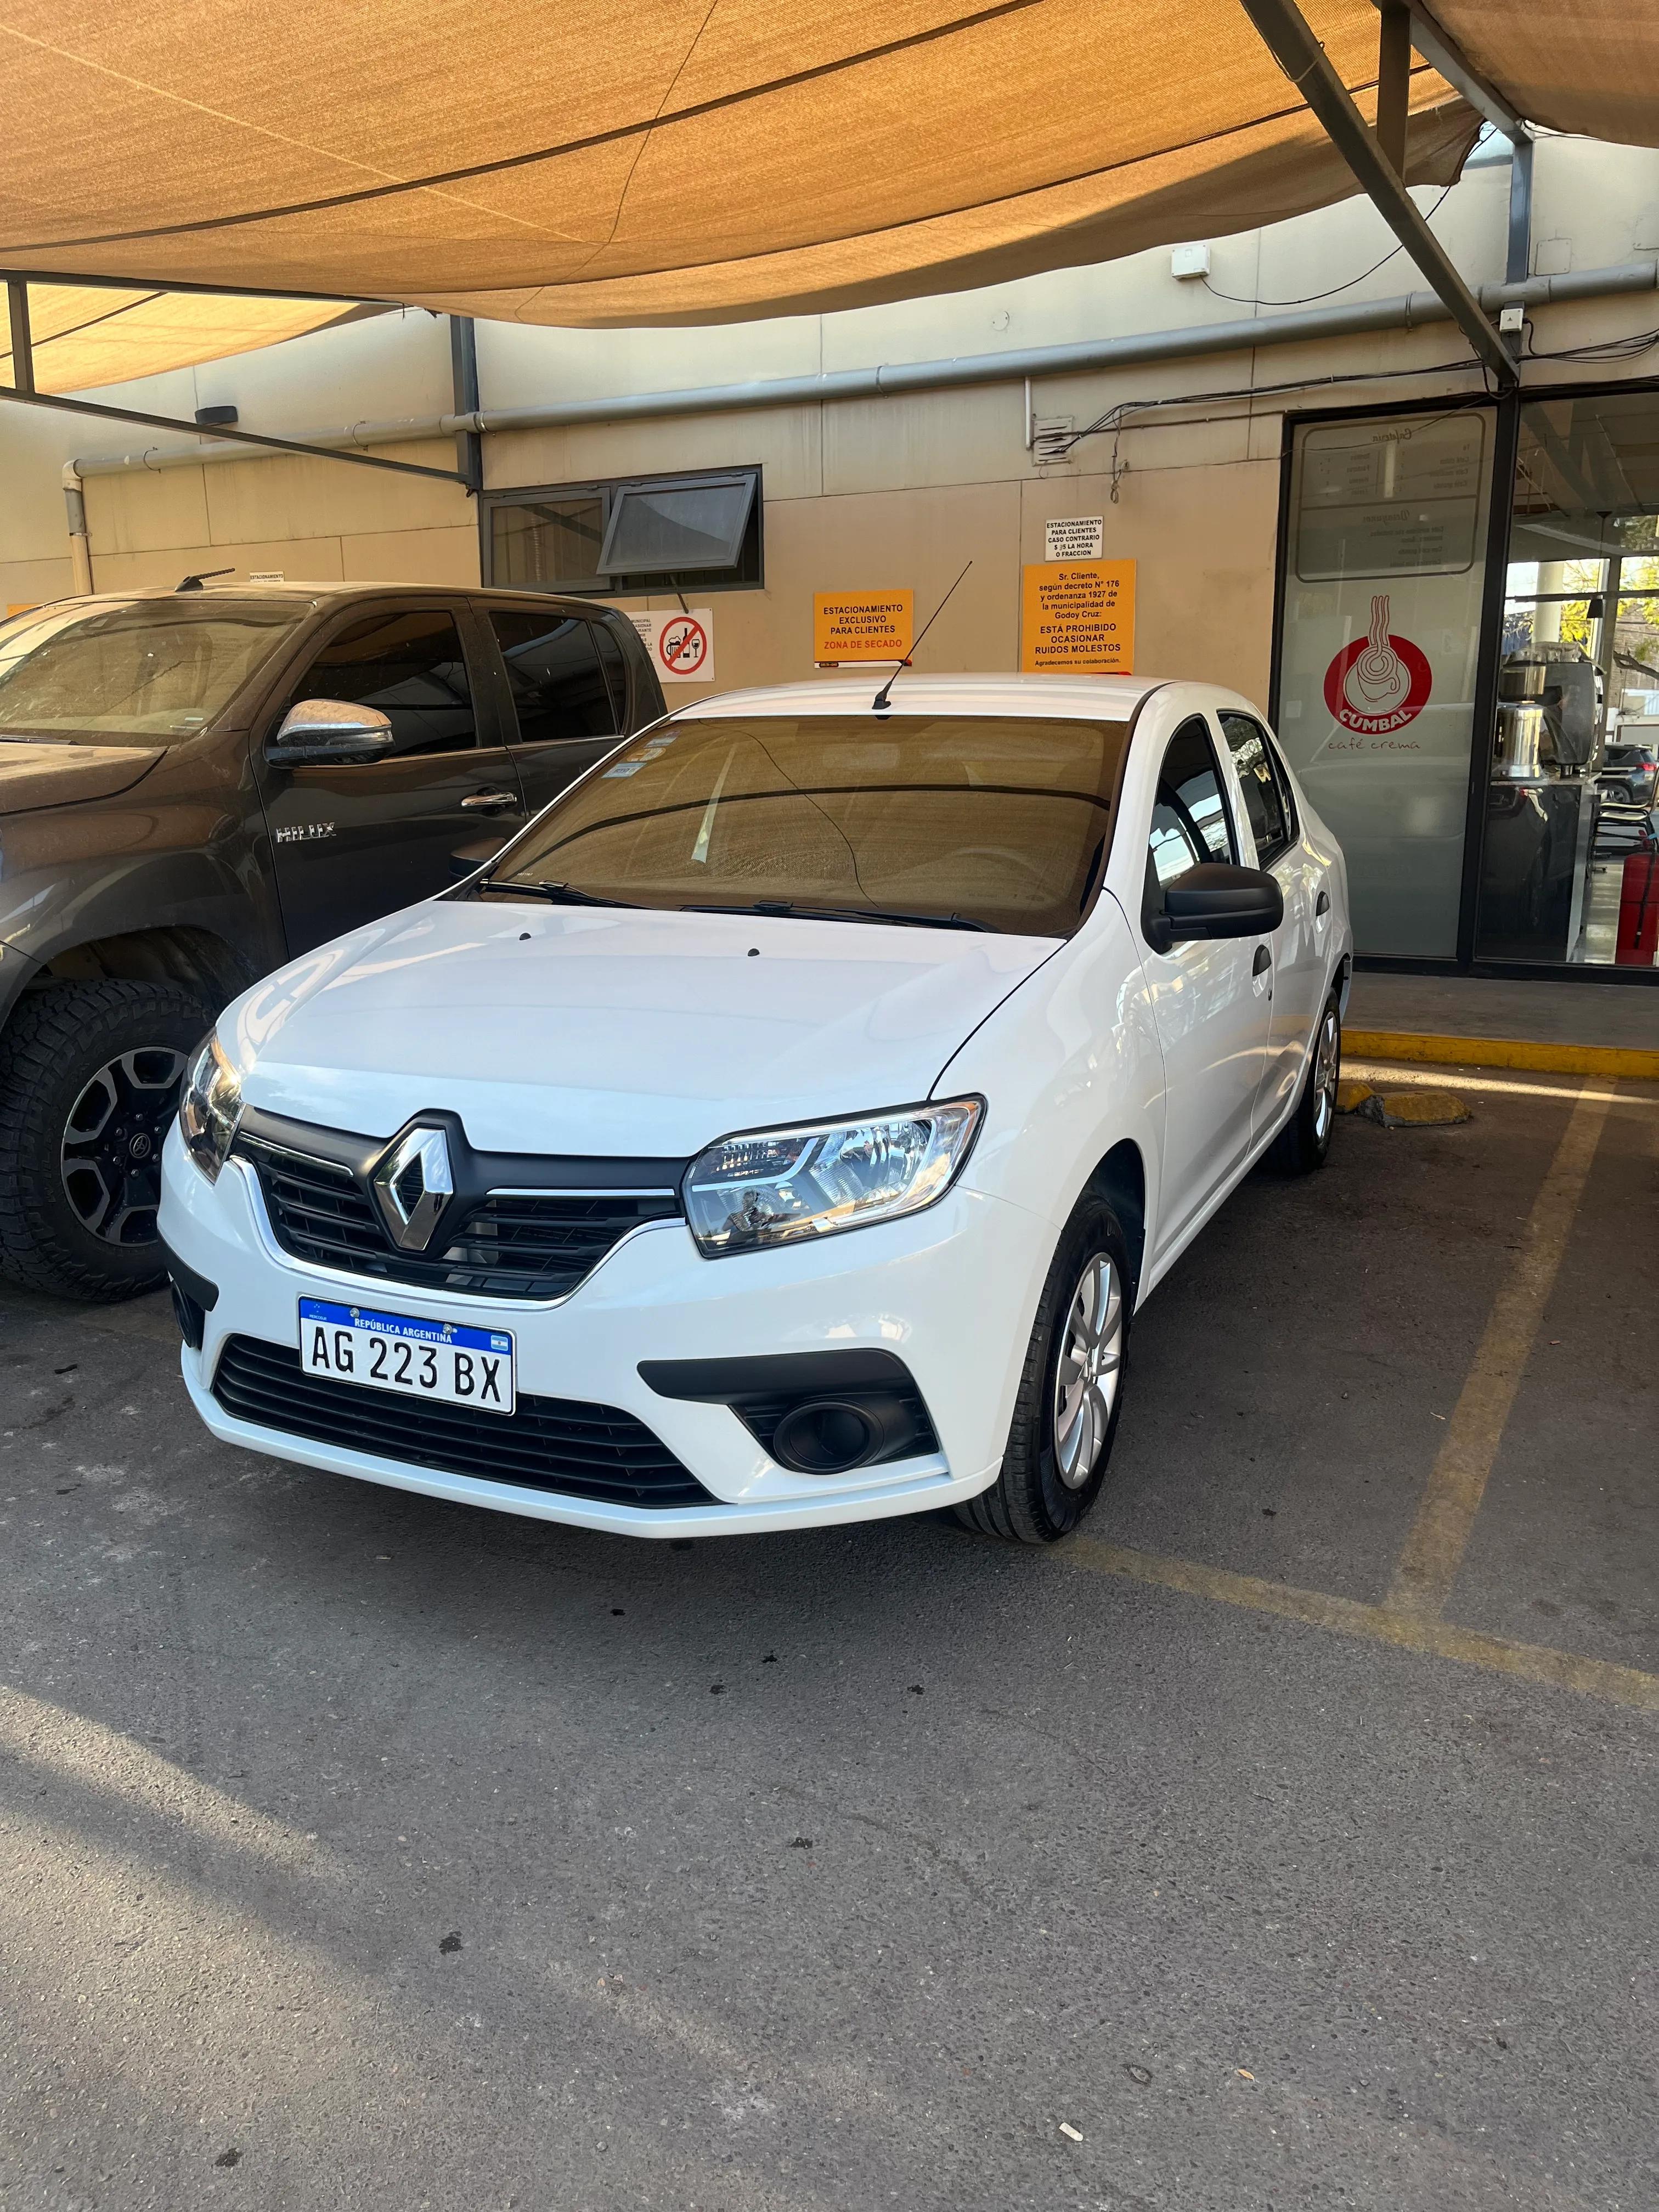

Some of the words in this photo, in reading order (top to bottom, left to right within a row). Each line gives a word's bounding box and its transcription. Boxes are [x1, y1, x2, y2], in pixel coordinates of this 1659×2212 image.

[1047, 520, 1102, 528] ESTACIONAMIENTO
[1039, 584, 1062, 592] según
[823, 604, 903, 615] ESTACIONAMIENTO
[1051, 601, 1103, 611] municipalidad
[839, 615, 887, 624] EXCLUSIVO
[831, 627, 853, 635] PARA
[855, 625, 895, 634] CLIENTES
[1040, 624, 1063, 634] ESTÁ
[1066, 623, 1116, 632] PROHIBIDO
[1051, 634, 1104, 643] OCASIONAR
[824, 641, 848, 650] ZONA
[850, 640, 862, 648] DE
[865, 639, 902, 648] SECADO
[1035, 645, 1069, 654] RUIDOS
[1071, 644, 1121, 653] MOLESTOS
[1339, 709, 1412, 732] CUMBAL
[1328, 737, 1365, 749] café
[1371, 741, 1421, 749] crema
[354, 1318, 400, 1335] REPÚBLICA
[403, 1329, 452, 1344] ARGENTINA
[312, 1326, 354, 1373] AG
[369, 1337, 438, 1389] 223
[454, 1351, 501, 1403] BX
